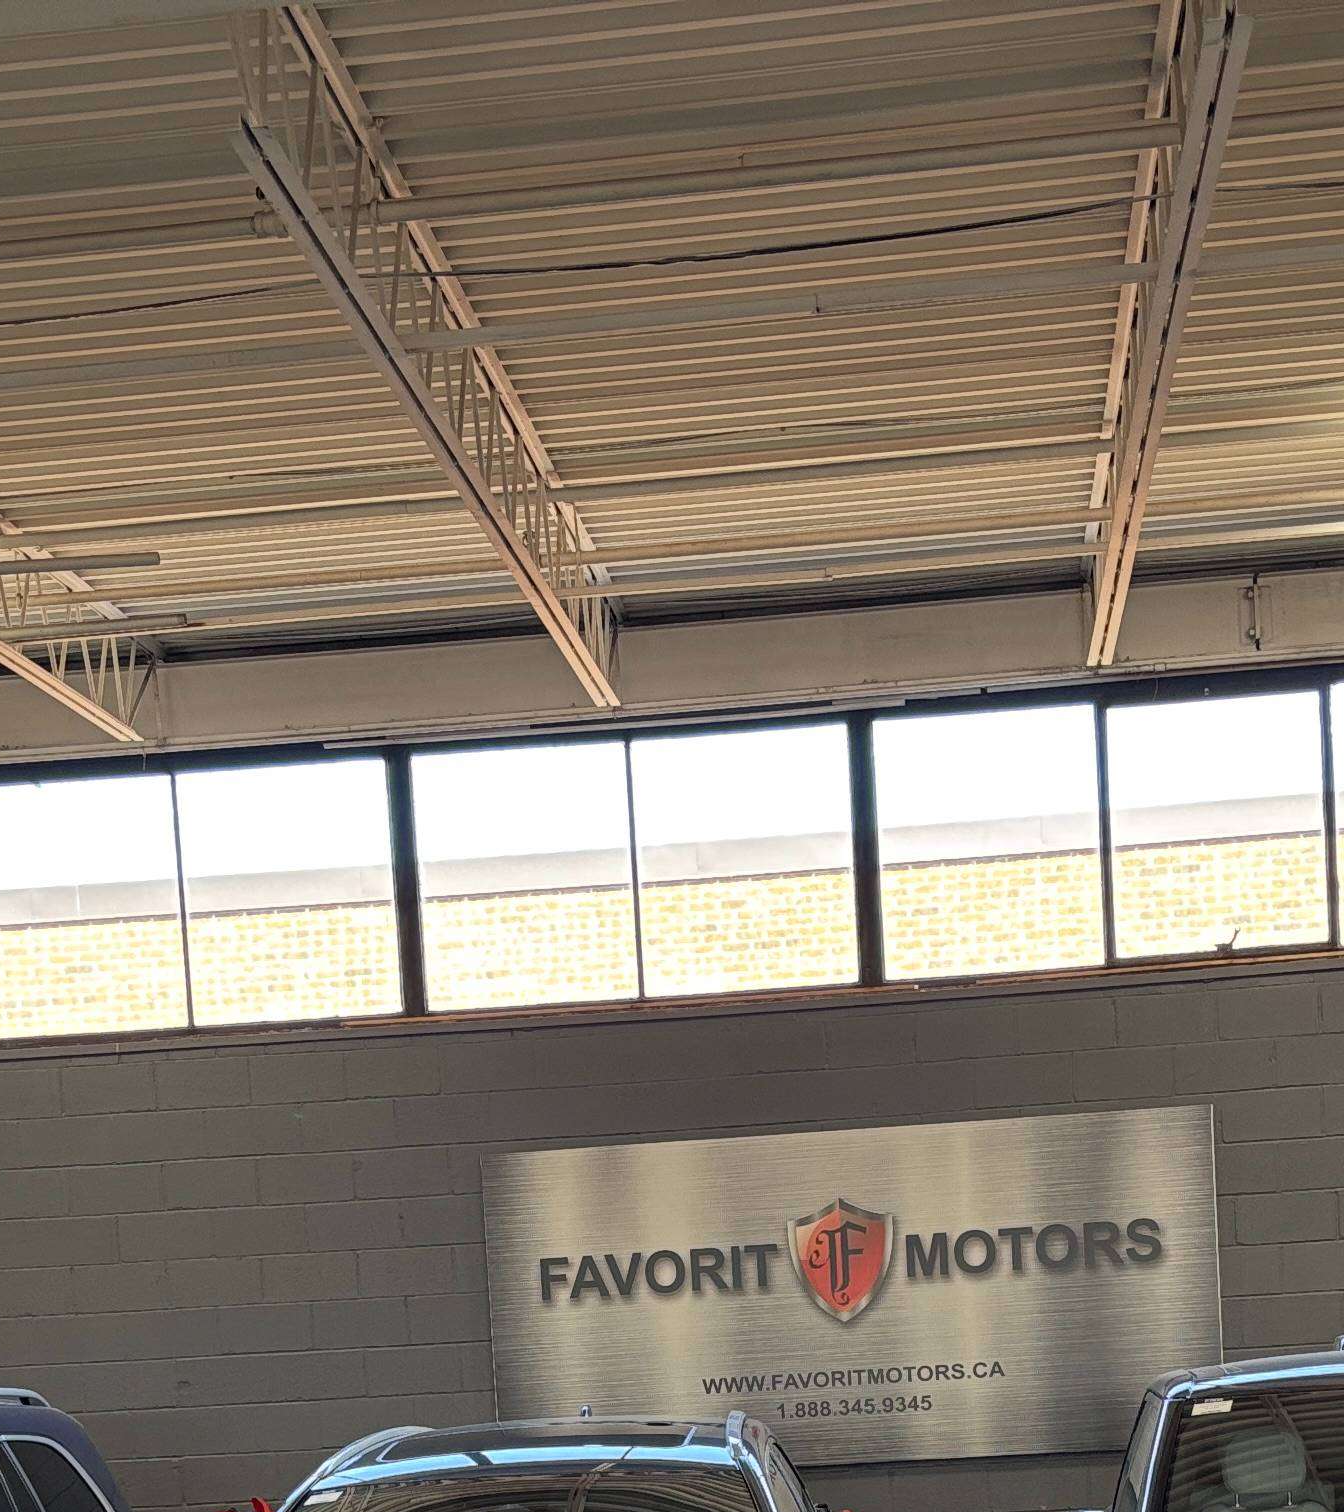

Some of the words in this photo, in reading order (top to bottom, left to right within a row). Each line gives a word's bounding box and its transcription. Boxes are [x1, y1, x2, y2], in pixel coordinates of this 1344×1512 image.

[539, 1242, 778, 1302] FAVORIT
[905, 1217, 1163, 1277] MOTORS
[702, 1360, 1006, 1395] WWW.FAVORITMOTORS.CA
[776, 1394, 933, 1420] 1.888.345.9345
